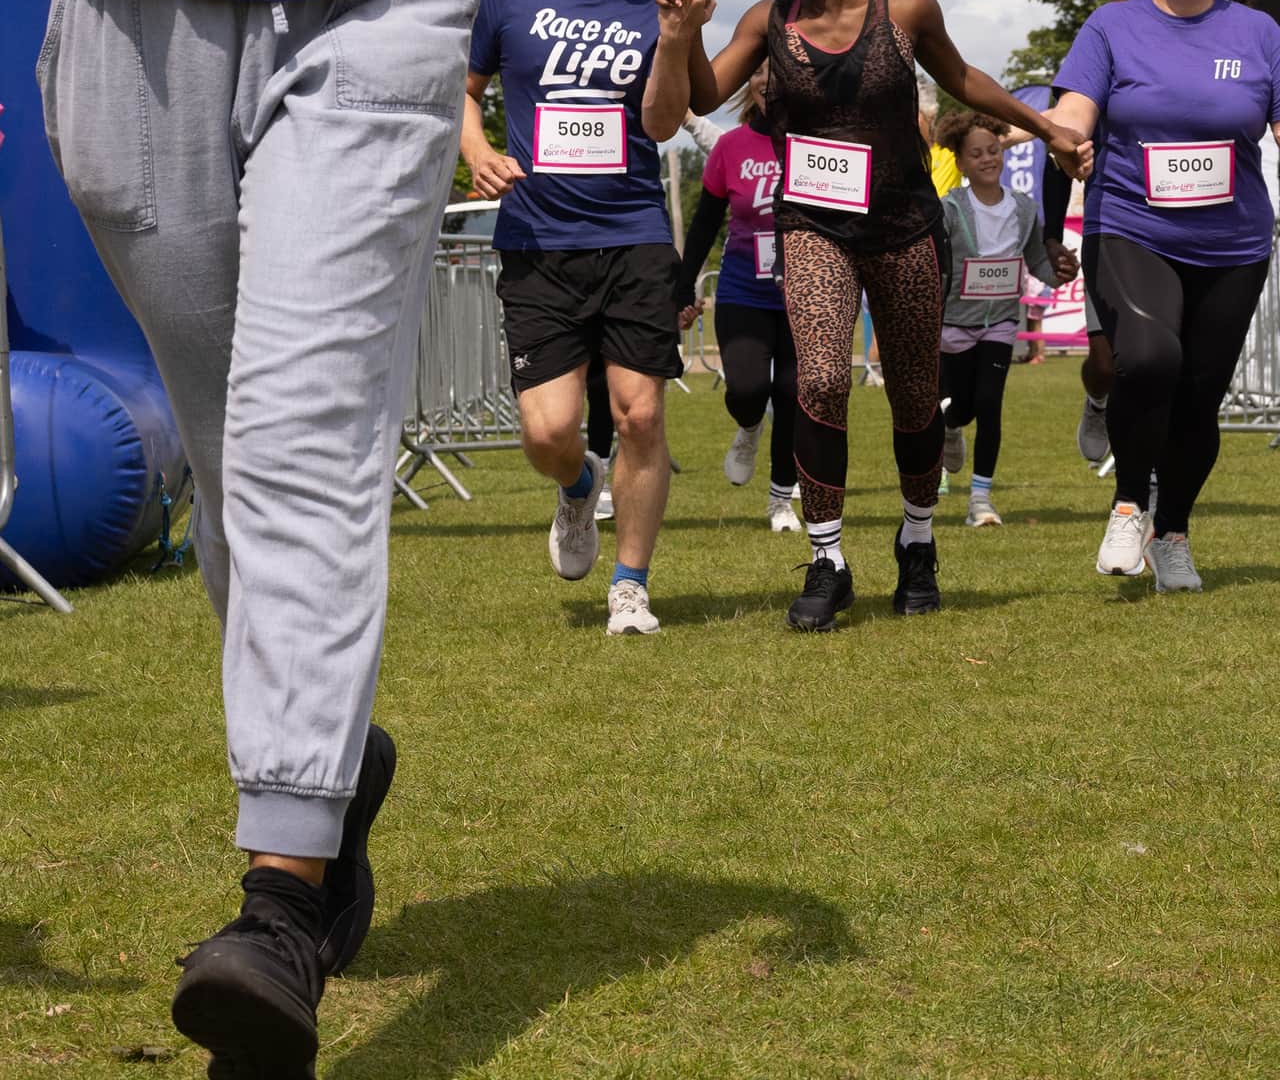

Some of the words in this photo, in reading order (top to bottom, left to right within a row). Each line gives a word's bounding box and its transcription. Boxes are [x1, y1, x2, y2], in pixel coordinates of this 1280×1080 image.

[529, 7, 601, 40] Race
[603, 21, 642, 45] for
[538, 40, 643, 87] Life
[1214, 59, 1241, 79] TFG
[558, 121, 605, 137] 5098
[807, 153, 849, 173] 5003
[1007, 139, 1035, 195] ets
[1168, 158, 1213, 172] 5000
[752, 176, 781, 208] Li
[979, 268, 1009, 278] 5005
